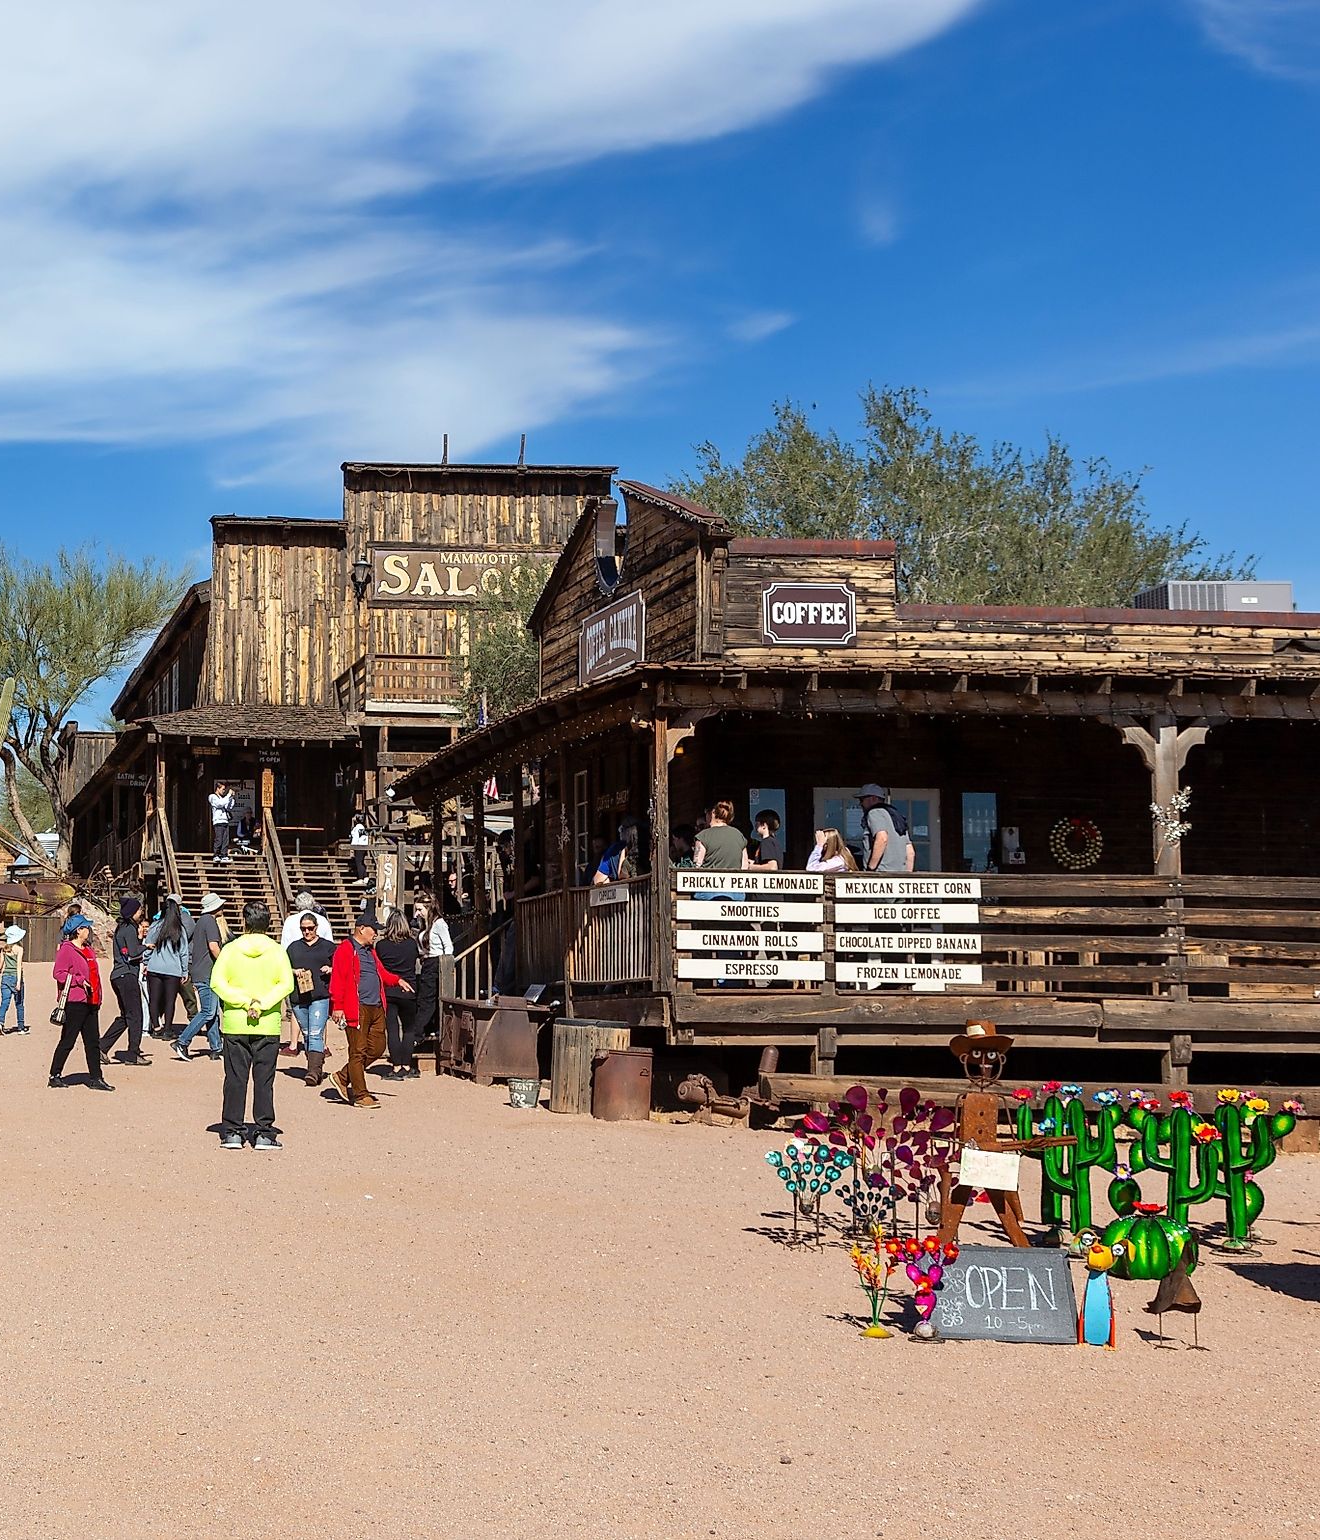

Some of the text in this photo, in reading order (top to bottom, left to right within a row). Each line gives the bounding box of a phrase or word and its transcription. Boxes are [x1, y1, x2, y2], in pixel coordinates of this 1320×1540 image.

[440, 553, 518, 564] MAMMOTH
[772, 601, 847, 625] COFFEE
[586, 603, 637, 675] COFFEE CANTINA
[682, 876, 819, 890] PRICKLY PEAR LEMONADE
[845, 882, 971, 894] MEXICAN STREET CORN
[720, 905, 780, 918] SMOOTHIES
[874, 907, 940, 920] ICED COFFEE
[702, 934, 798, 947] CINNAMON ROLLS
[839, 936, 977, 950] CHOCOLATE DIPPED BANANA
[725, 963, 779, 975] ESPRESSO
[857, 967, 962, 980] FROZEN LEMONADE
[965, 1264, 1059, 1311] OPEN
[984, 1314, 1003, 1329] 10
